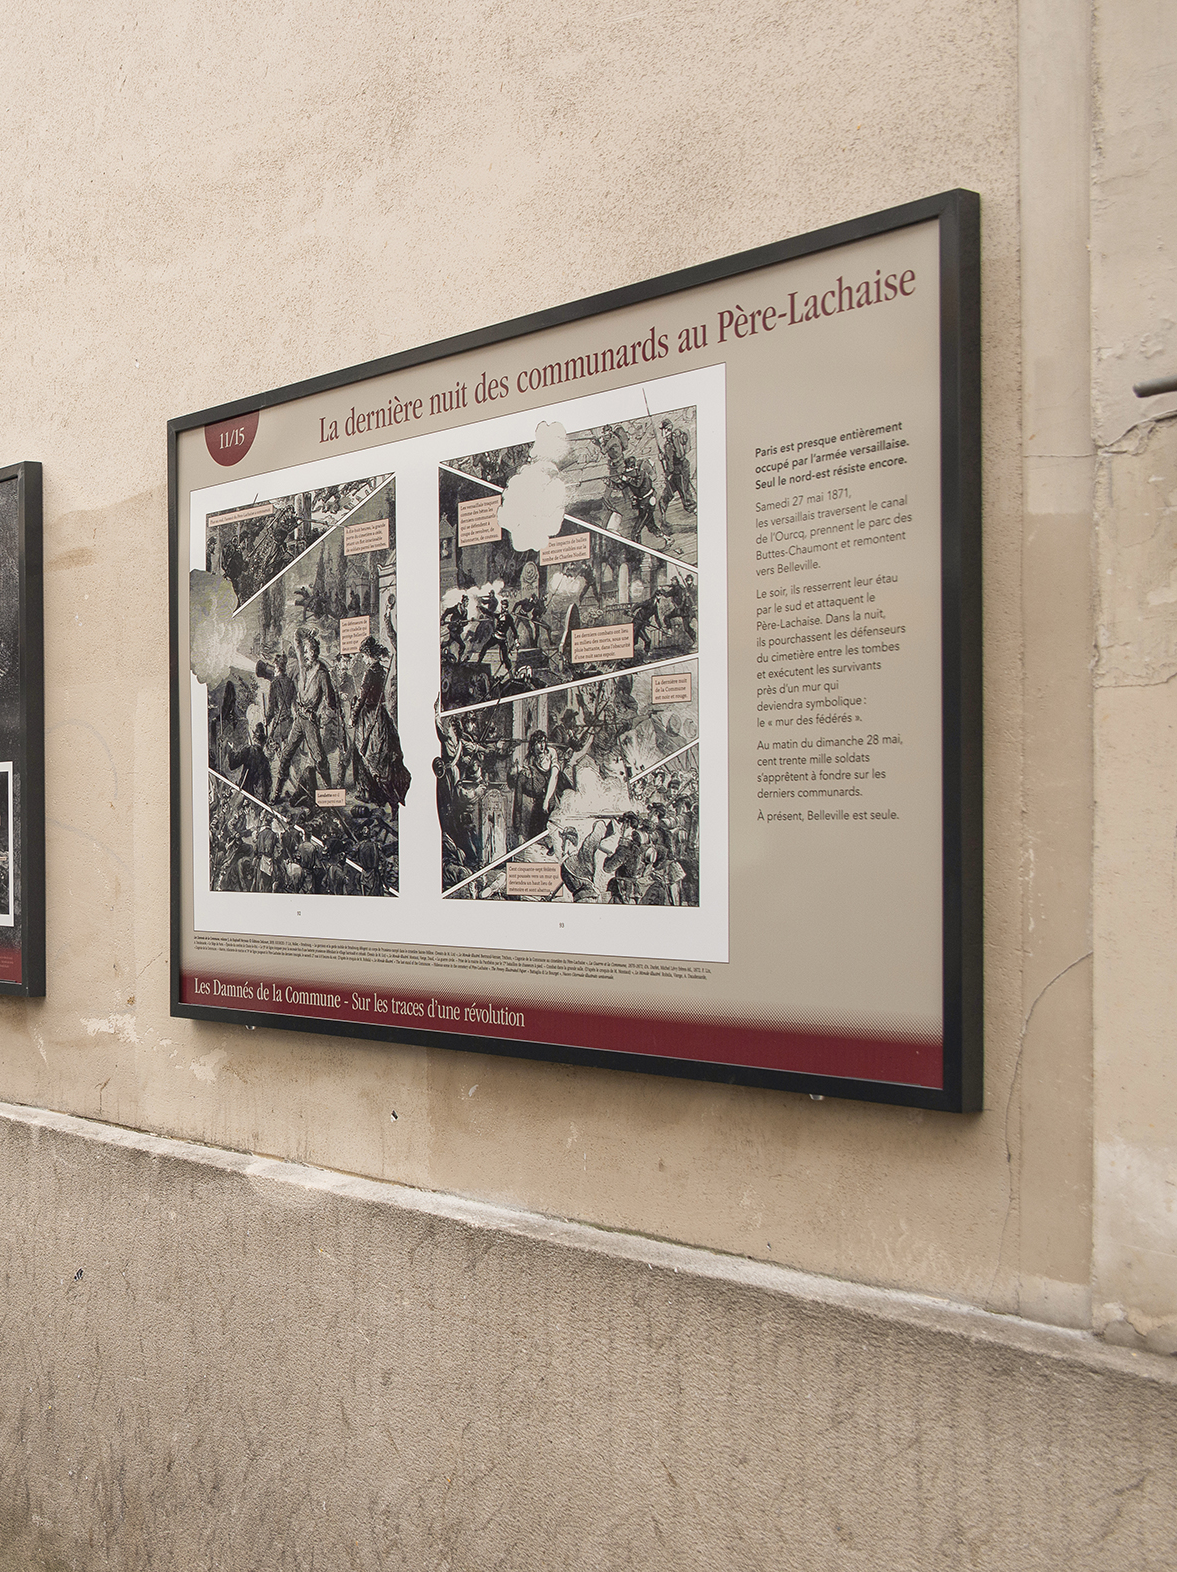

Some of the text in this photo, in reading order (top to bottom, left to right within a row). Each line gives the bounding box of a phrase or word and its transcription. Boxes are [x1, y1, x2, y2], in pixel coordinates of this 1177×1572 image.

[319, 269, 916, 444] La dernière nuit des communards au Père-Lachaise
[220, 427, 245, 449] 11/15
[755, 422, 903, 458] Paris est presque entièrement
[755, 438, 910, 474] occupé par l'armée versaillaise.
[755, 457, 907, 490] Seul le nord-est résiste encore.
[755, 488, 852, 513] Samedi 27 mai 1871,
[756, 494, 908, 528] les versaillais traversent le canal
[756, 512, 913, 545] de l'Ourcq, prennent le parc des
[756, 531, 906, 561] Buttes-Chaumont et remontent
[756, 559, 821, 576] vers Belleville.
[756, 574, 898, 599] Le soir, ils resserrent leur étau
[756, 592, 876, 618] par le sud et attaquent le
[757, 608, 886, 631] Père-Lachaise. Dans la nuit,
[757, 625, 906, 649] ils pourchassent les défenseurs
[756, 642, 900, 664] du cimetière entre les tombes
[756, 662, 882, 680] et exécutent les survivants
[757, 680, 839, 698] près d'un mur qui
[757, 699, 803, 712] deviendra
[757, 718, 765, 728] le
[775, 718, 794, 726] mur
[796, 715, 814, 726] des
[816, 712, 853, 724] fédérés
[756, 733, 903, 750] Au matin du dimanche 28 mai,
[757, 752, 870, 767] cent trente mille soldats
[757, 768, 886, 785] s'apprêtent à fondre sur les
[757, 786, 863, 799] derniers communards.
[757, 809, 900, 823] À présent, Belleville est seule.
[194, 978, 211, 995] Les
[213, 979, 254, 999] Damnés
[257, 984, 269, 1001] de
[273, 985, 283, 1002] la
[285, 986, 341, 1008] Commune
[352, 993, 371, 1011] Sur
[374, 995, 388, 1013] les
[391, 998, 424, 1016] traces
[428, 1001, 460, 1020] d'une
[464, 1007, 525, 1027] révolution
